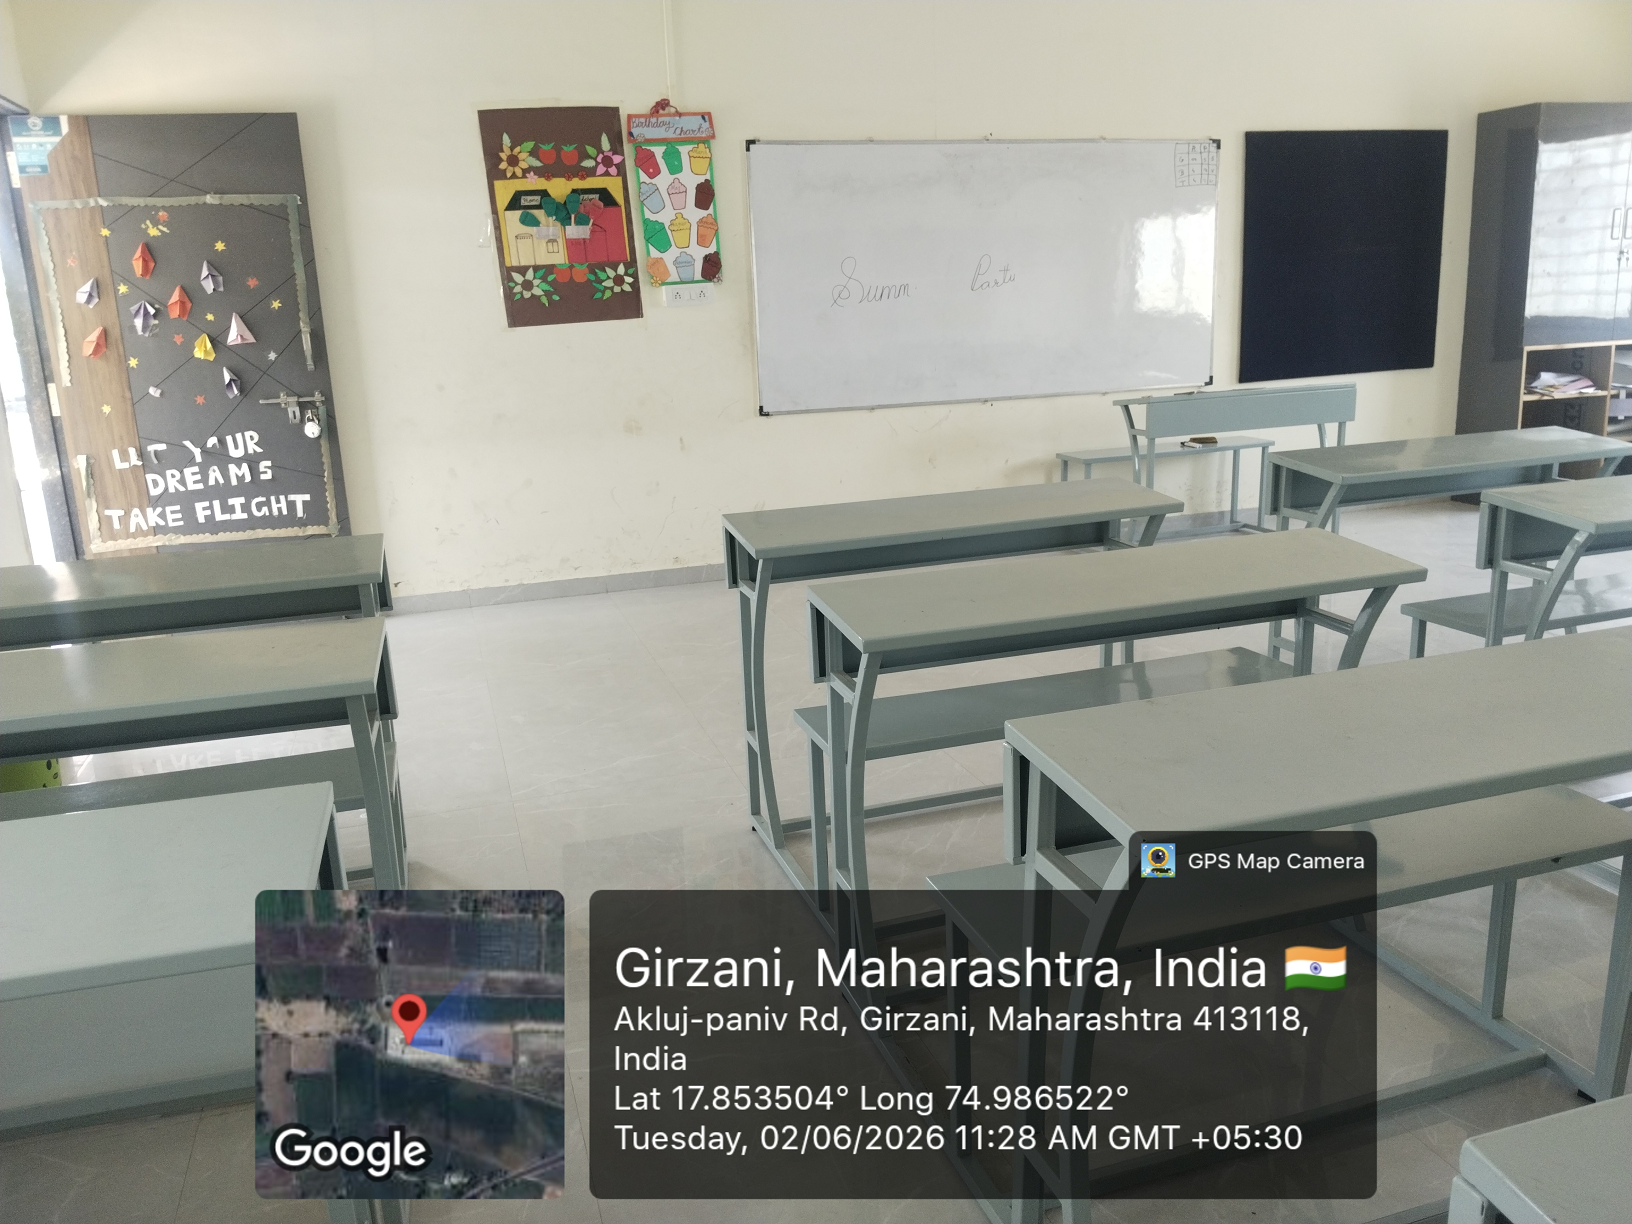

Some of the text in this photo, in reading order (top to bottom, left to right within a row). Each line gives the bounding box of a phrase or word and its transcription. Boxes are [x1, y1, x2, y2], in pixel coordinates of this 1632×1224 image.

[631, 117, 675, 133] Birthday
[672, 123, 704, 136] Chart
[145, 460, 273, 496] DREAMS
[104, 493, 311, 533] TAKE FLIGHT
